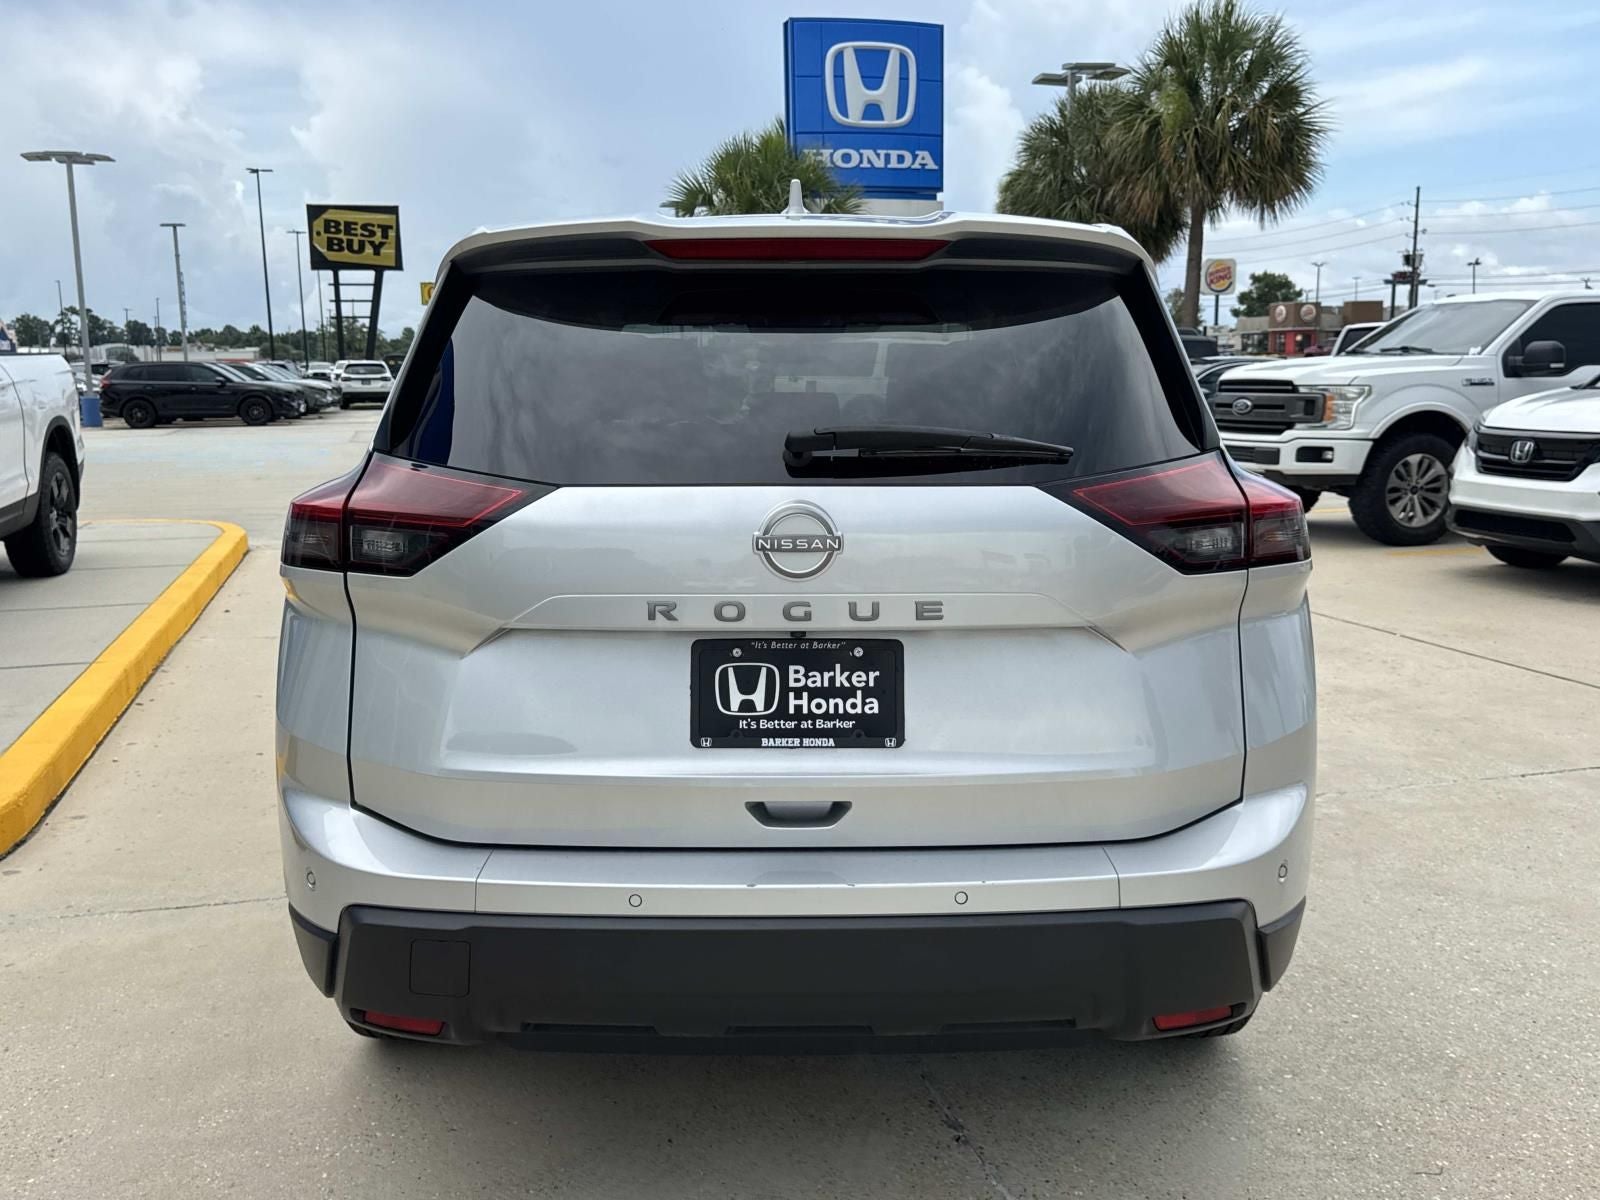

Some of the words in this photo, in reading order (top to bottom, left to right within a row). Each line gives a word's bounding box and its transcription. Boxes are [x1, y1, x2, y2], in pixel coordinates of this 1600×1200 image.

[803, 149, 939, 170] HONDA
[323, 218, 394, 240] BEST
[326, 236, 388, 257] BUY
[757, 538, 839, 550] NISSAN
[646, 600, 945, 623] ROGUE
[771, 641, 798, 649] Better
[788, 663, 880, 688] Barker
[788, 690, 879, 715] Honda
[739, 718, 757, 729] It's
[759, 718, 798, 729] Better
[800, 719, 813, 729] at
[815, 718, 856, 729] Barker
[761, 738, 800, 747] BARKER
[802, 738, 836, 747] HONDA
